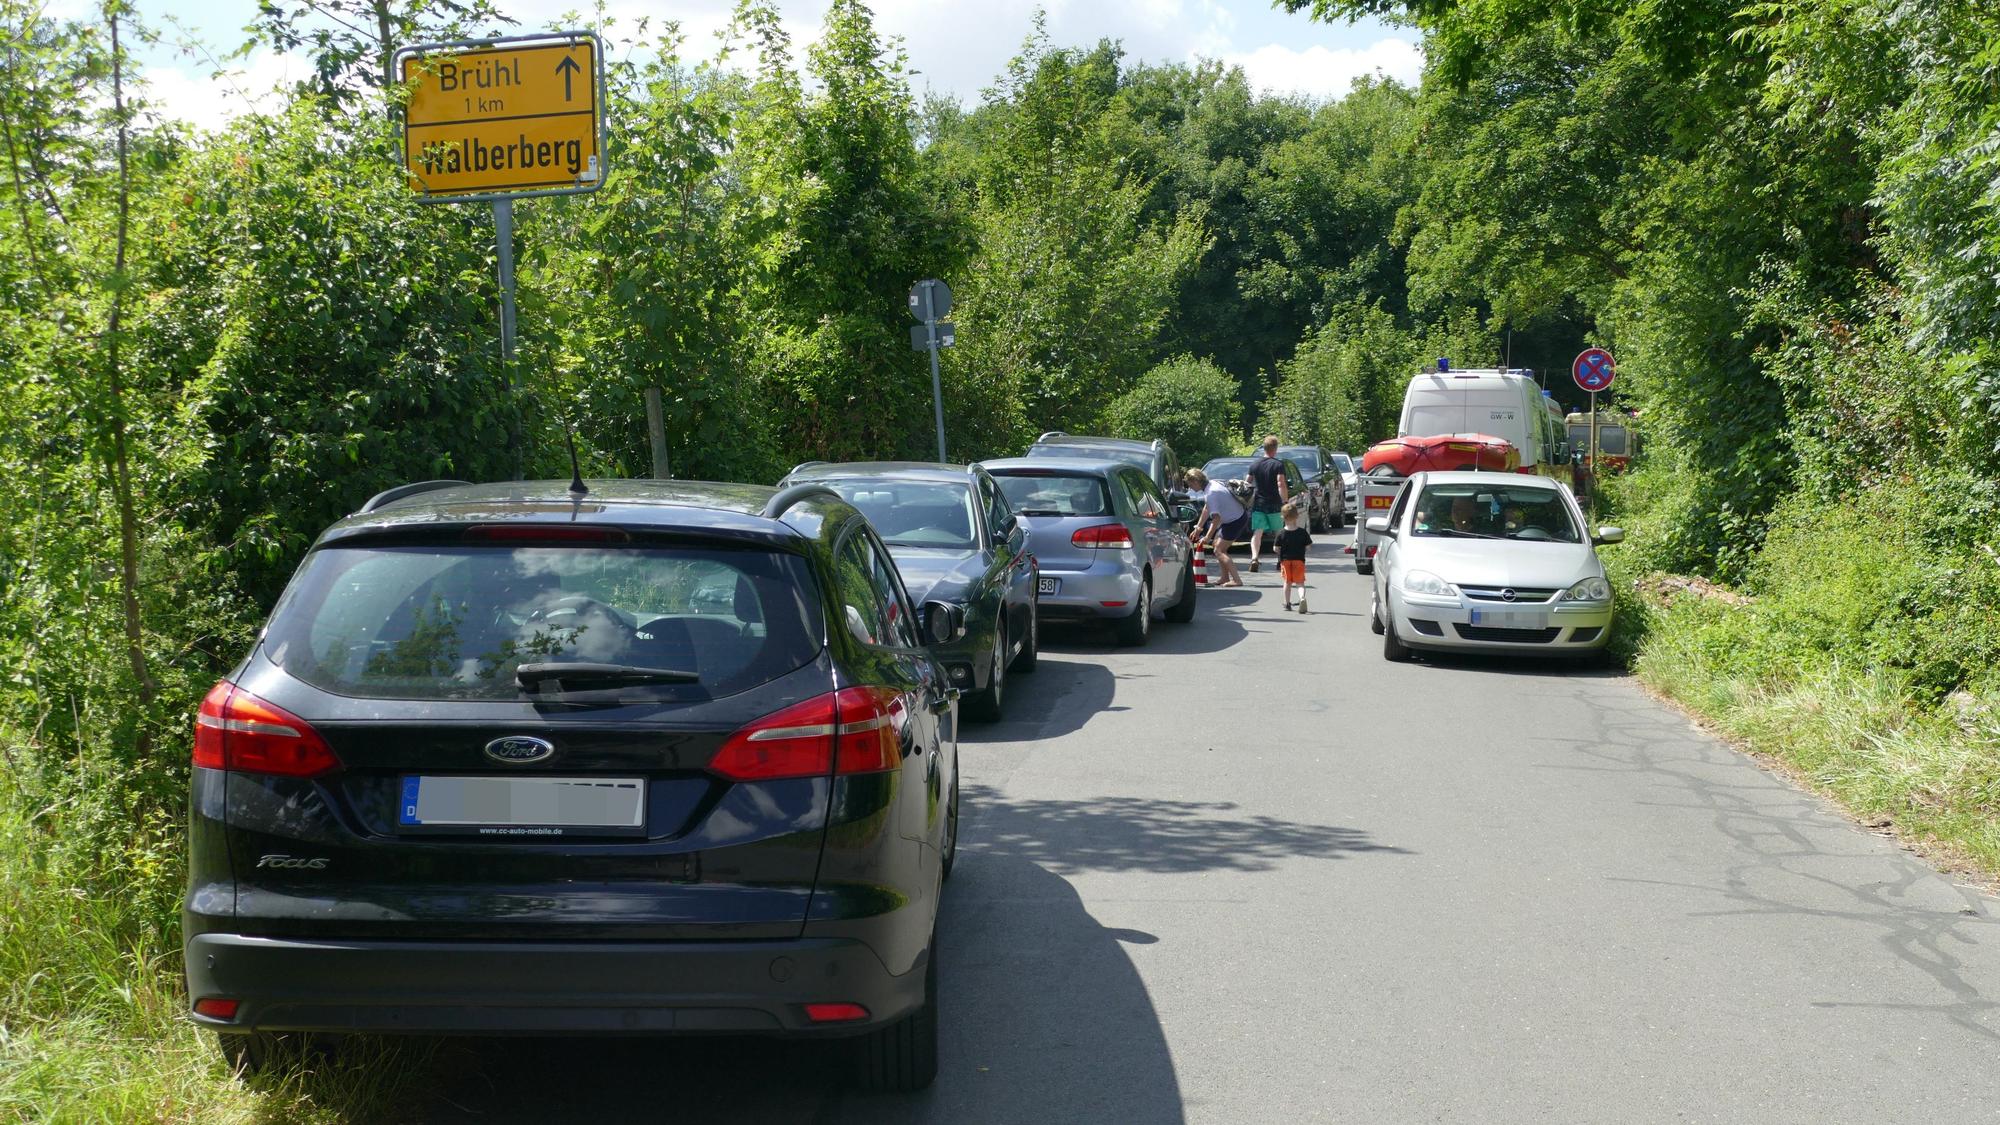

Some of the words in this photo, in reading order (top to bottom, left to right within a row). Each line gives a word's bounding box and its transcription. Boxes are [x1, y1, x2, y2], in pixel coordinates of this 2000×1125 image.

[440, 57, 521, 92] Brühl
[465, 98, 471, 113] 1
[479, 97, 504, 113] km
[422, 134, 581, 175] Walberberg
[500, 740, 538, 757] Ford
[406, 805, 416, 817] D
[479, 827, 563, 836] www.cc-auto-mobile.de
